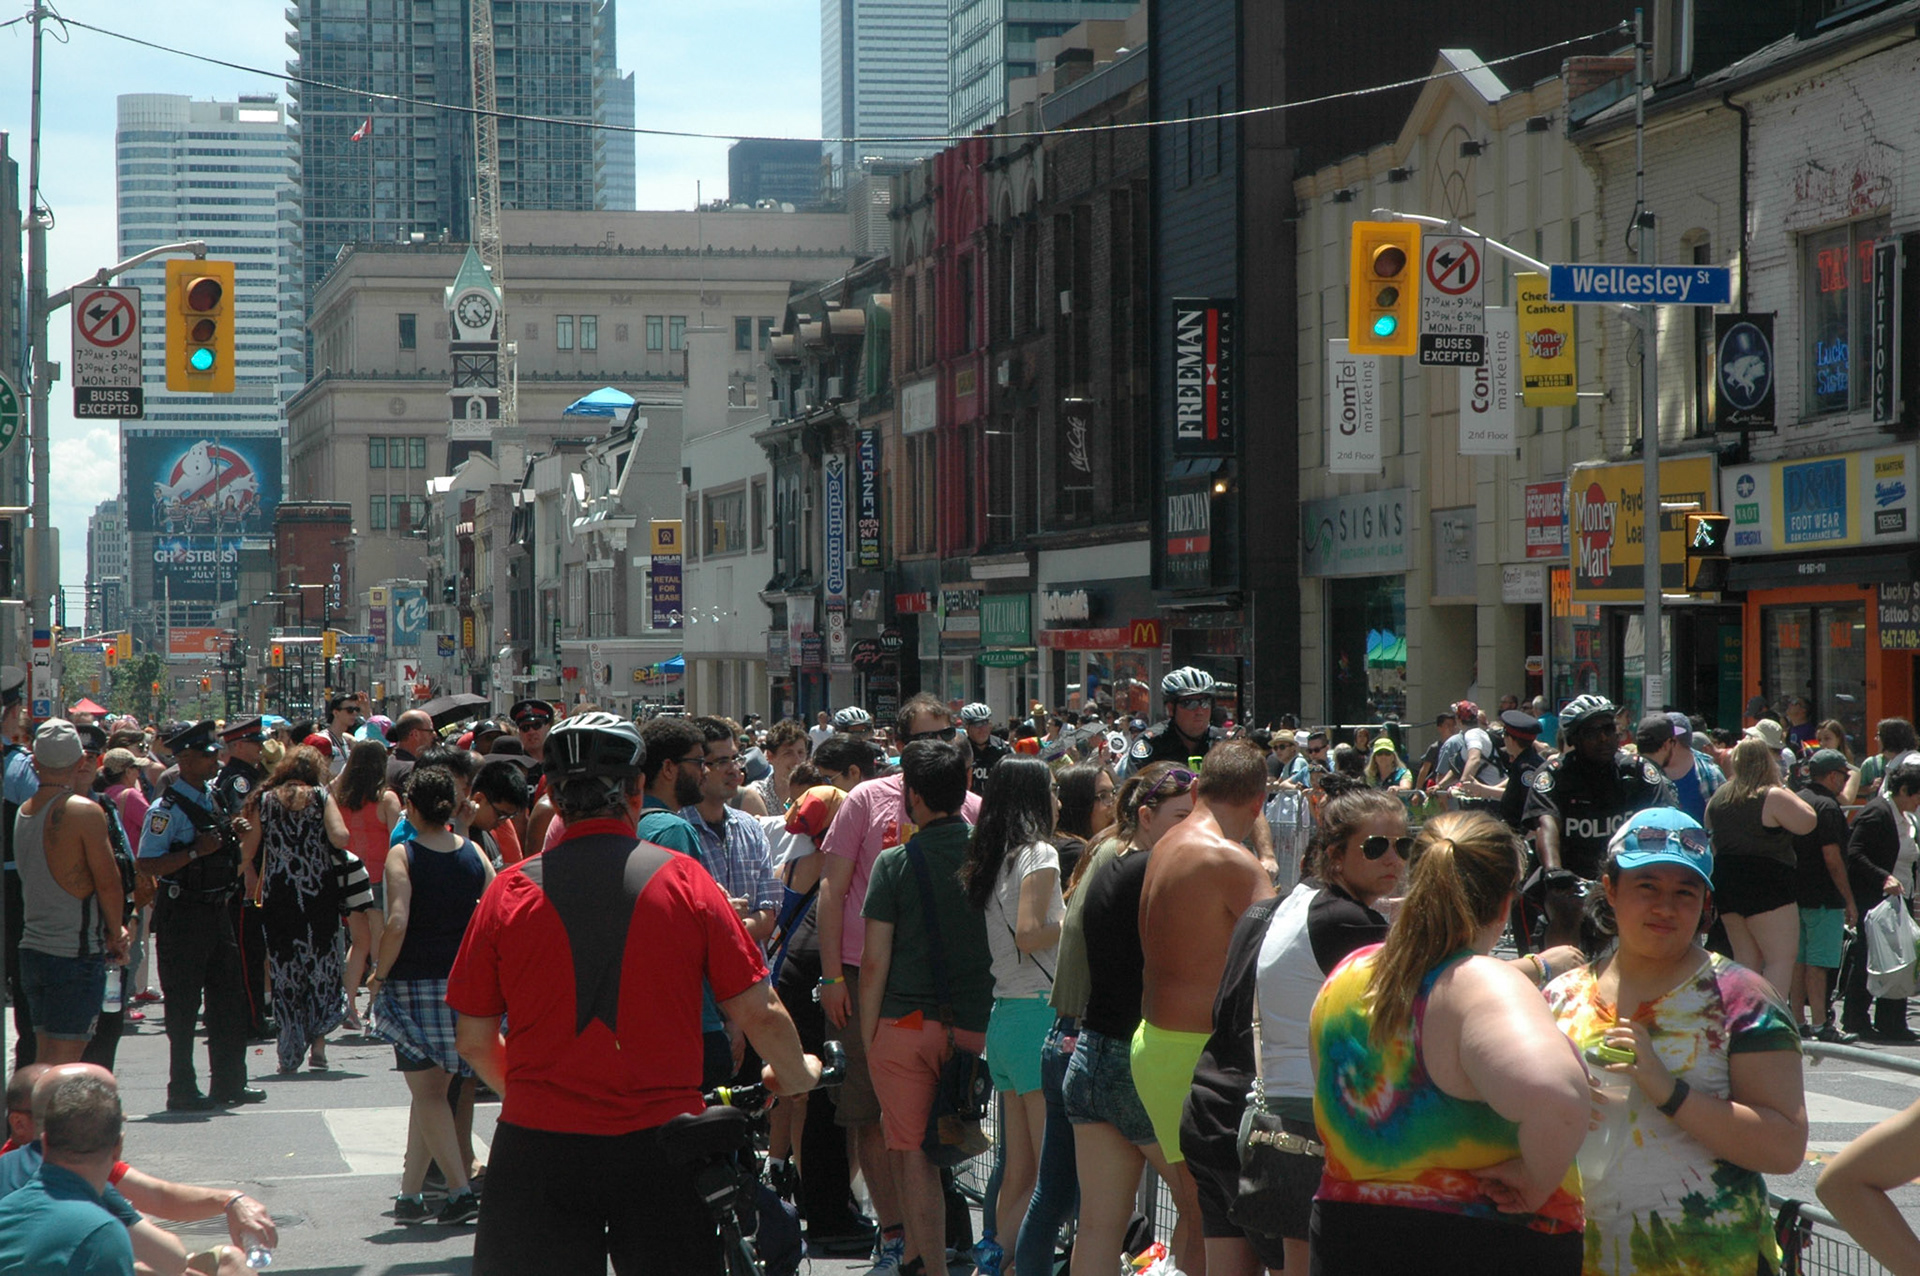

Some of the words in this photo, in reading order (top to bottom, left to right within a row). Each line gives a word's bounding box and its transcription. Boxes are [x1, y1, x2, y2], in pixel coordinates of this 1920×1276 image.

[1572, 268, 1692, 301] Wellesley
[1697, 270, 1710, 284] St
[1526, 304, 1566, 315] Cashed
[1525, 331, 1567, 347] Money
[1876, 250, 1885, 419] TATTOOS
[1435, 338, 1472, 350] BUSES
[1528, 344, 1563, 359] Mart
[1423, 350, 1481, 363] EXCEPTED
[1177, 308, 1203, 439] FREEMAN
[1496, 330, 1510, 410] marketing
[90, 390, 130, 402] BUSES
[1363, 360, 1376, 434] marketing
[79, 403, 139, 415] EXCEPTED
[1467, 430, 1485, 440] 2nd
[1487, 430, 1508, 440] Floor
[1336, 451, 1353, 461] 2nd
[1354, 451, 1375, 461] Floor
[861, 430, 875, 518] INTERNET
[828, 480, 843, 536] adult
[1736, 506, 1757, 521] NAOT
[858, 518, 880, 528] OPEN
[1339, 502, 1402, 542] SIGNS
[1574, 490, 1618, 547] Money
[1790, 514, 1812, 531] FOOT
[1814, 511, 1840, 529] WEAR
[860, 527, 879, 538] 24/7
[829, 537, 843, 590] mart
[1578, 537, 1613, 577] Mart
[191, 571, 215, 579] JULY
[221, 571, 232, 579] 15
[653, 576, 681, 584] RETAIL
[332, 563, 341, 610] Yonge
[658, 584, 676, 593] FOR
[1880, 582, 1911, 604] Lucky
[654, 593, 681, 601] LEASE
[1879, 604, 1910, 623] Tattoo
[1880, 629, 1920, 648] 647-748-
[982, 653, 1025, 661] PIZZAIOLO
